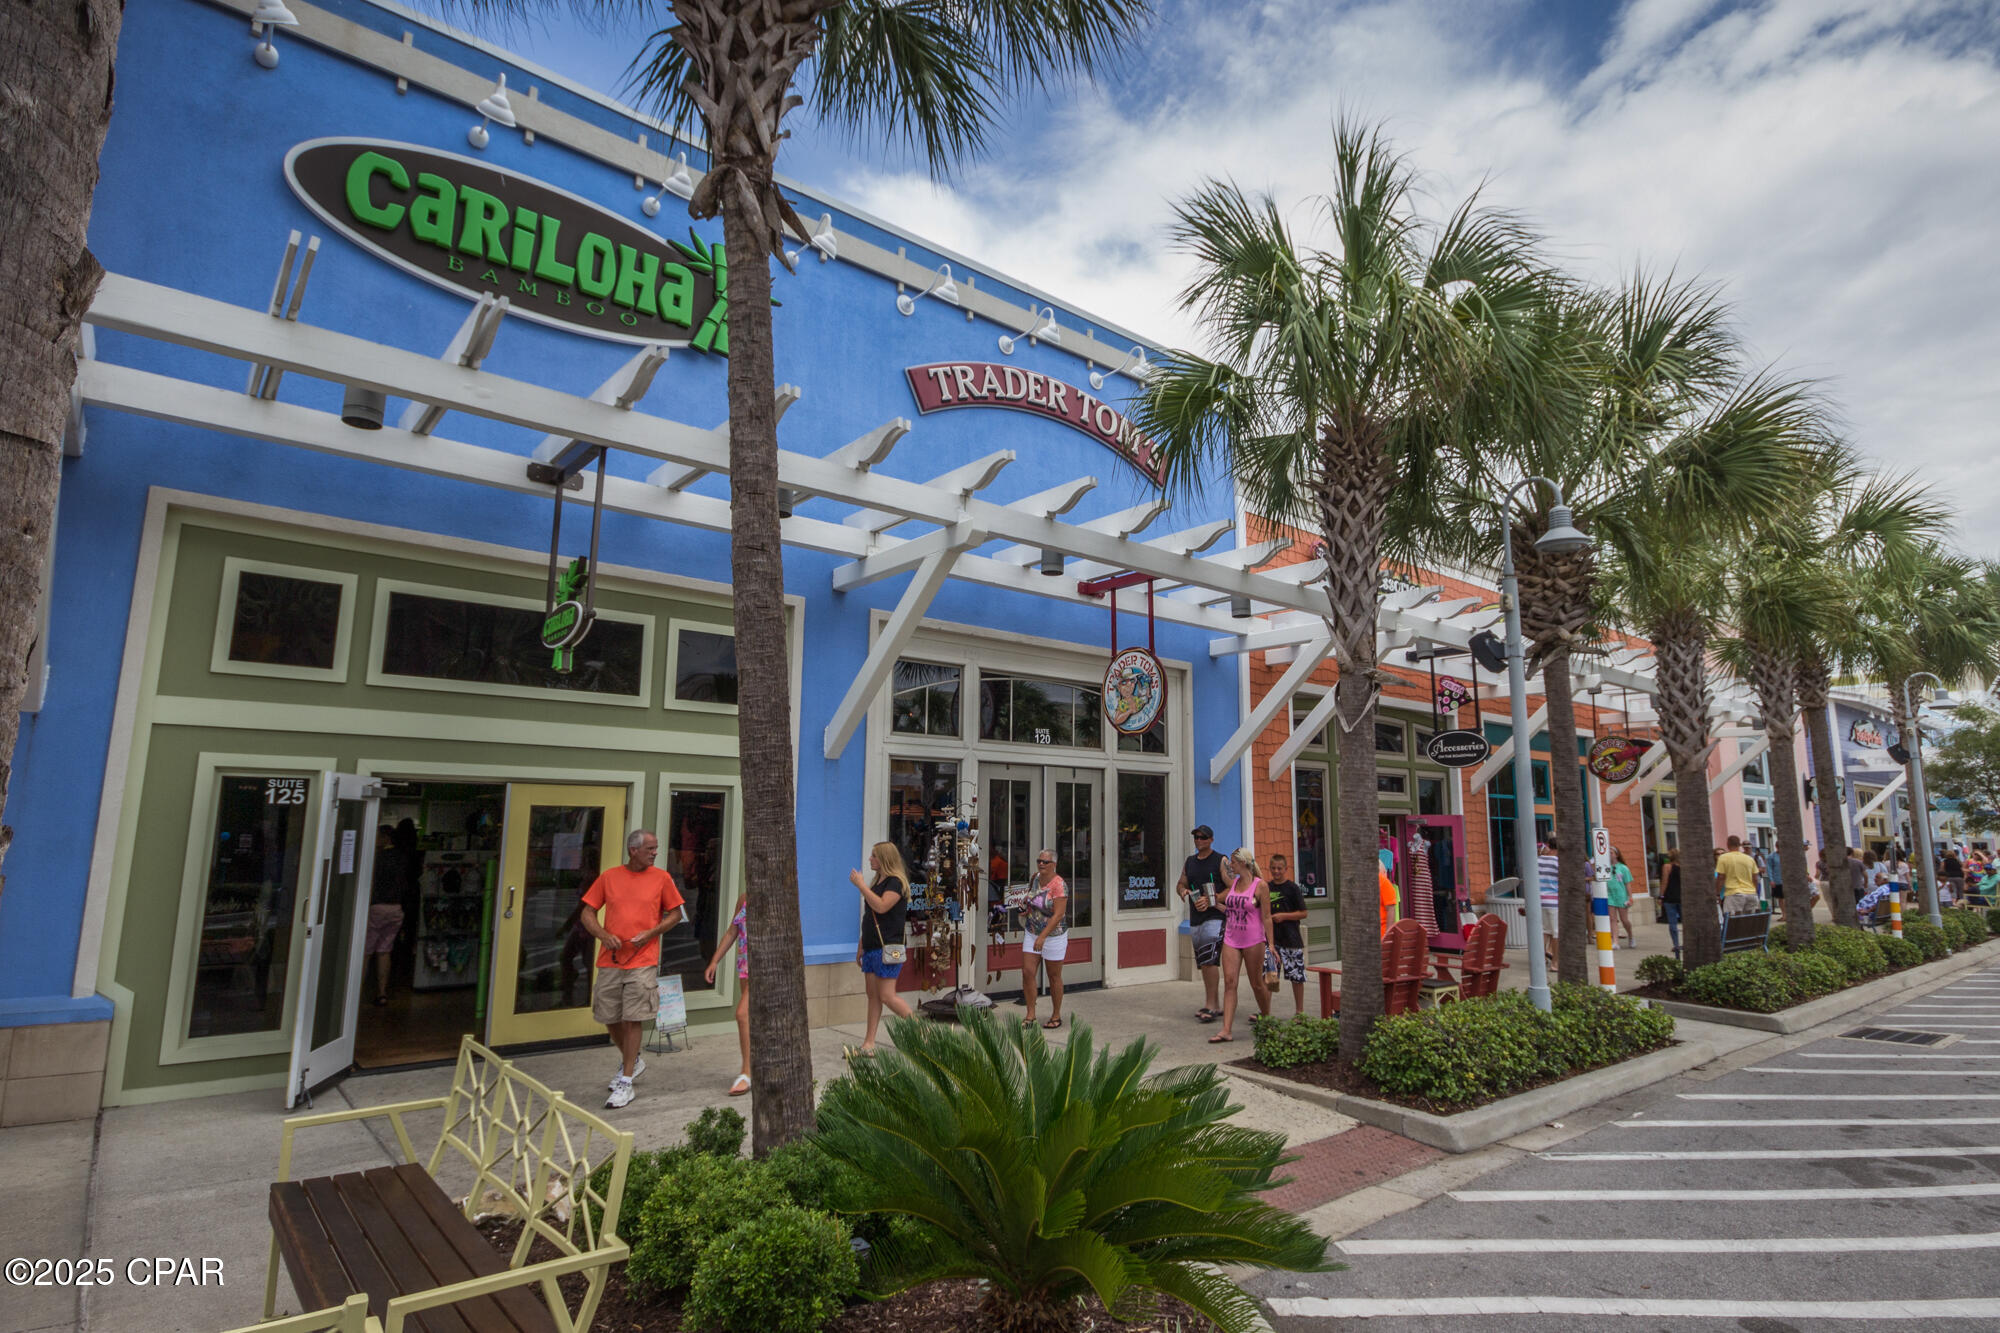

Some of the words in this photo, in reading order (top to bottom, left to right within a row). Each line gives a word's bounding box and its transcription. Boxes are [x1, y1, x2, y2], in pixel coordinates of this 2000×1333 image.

[447, 254, 639, 328] BAMBOO
[928, 364, 1069, 415] TRADER
[1106, 655, 1137, 694] TRADER
[1140, 656, 1159, 689] TOM'S
[1034, 734, 1051, 744] 120
[1592, 738, 1625, 756] PEPPER
[1430, 740, 1485, 757] Accessories
[1606, 760, 1637, 780] PALACE
[267, 779, 304, 788] SUITE
[264, 788, 305, 805] 125
[1128, 875, 1156, 888] BOOKS
[1124, 888, 1160, 901] JEWELRY
